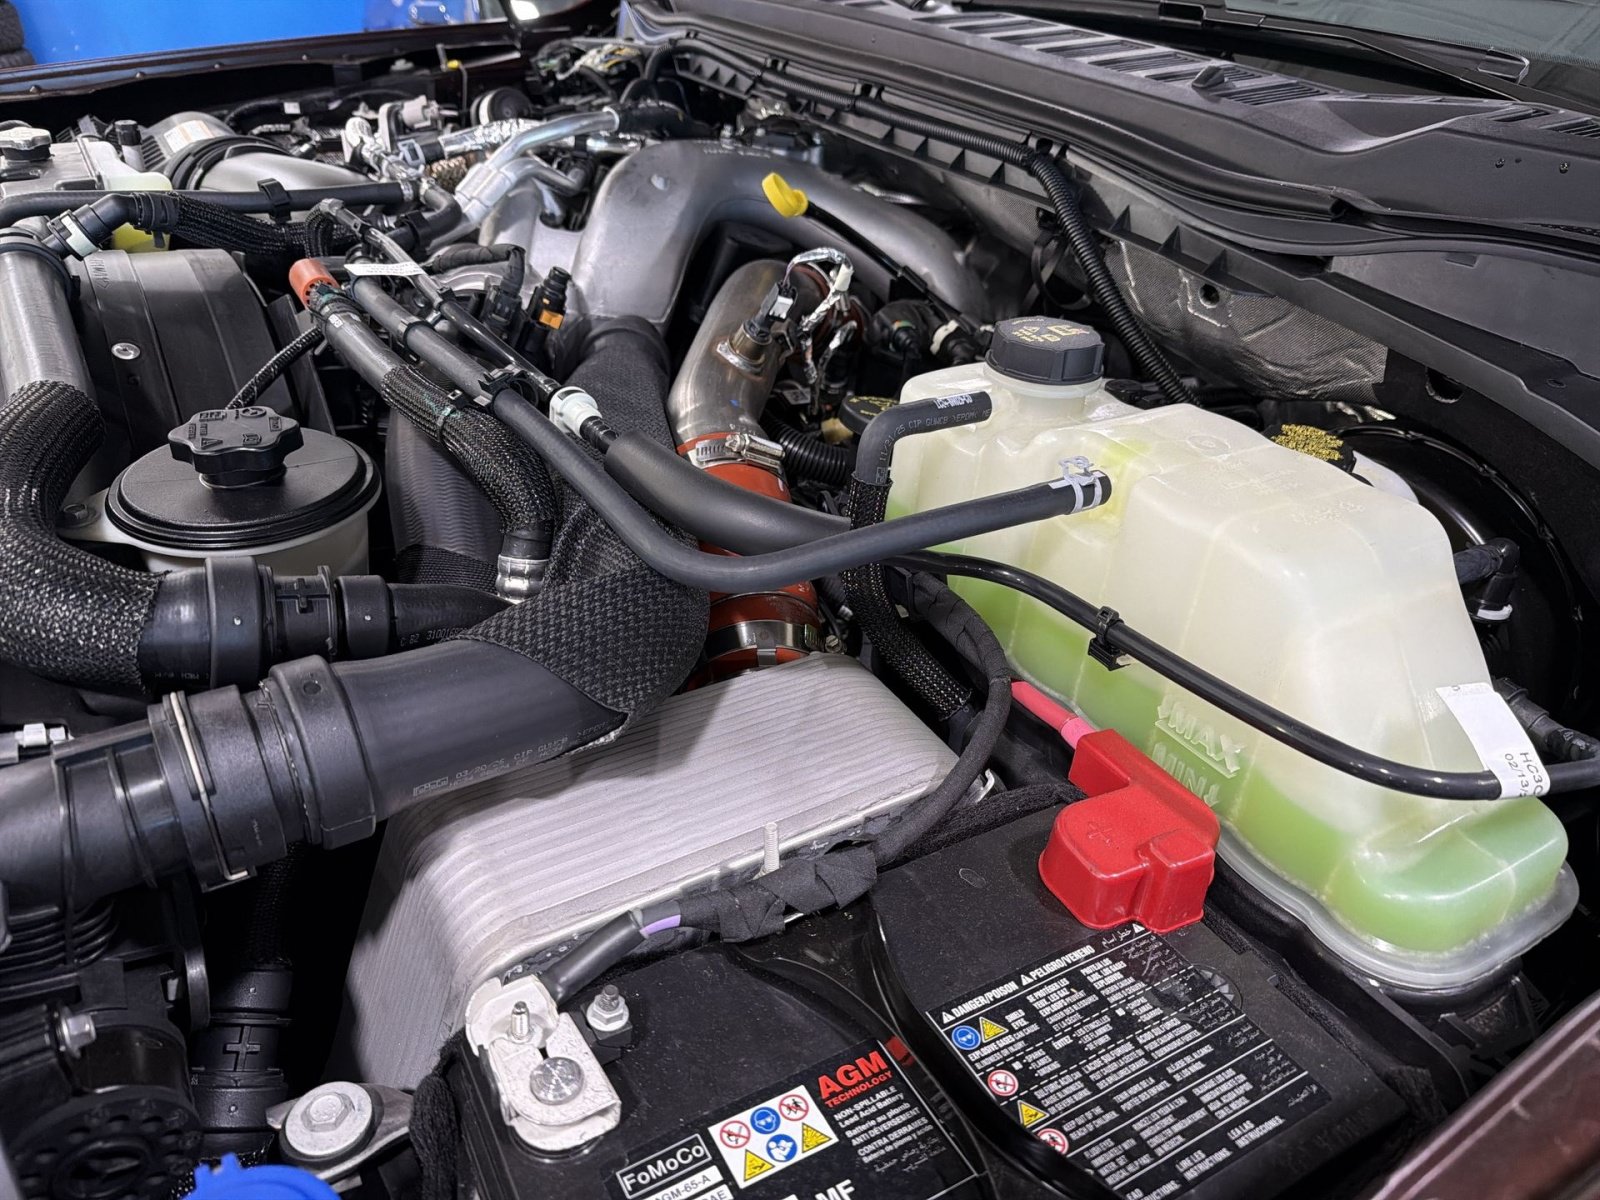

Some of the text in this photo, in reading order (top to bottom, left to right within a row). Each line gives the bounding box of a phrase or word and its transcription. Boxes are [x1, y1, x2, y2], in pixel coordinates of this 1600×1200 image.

[1165, 703, 1245, 773] MAX
[951, 981, 1018, 1016] DANGER/POISON
[1029, 945, 1094, 979] PELIGRO/VENENO
[818, 1051, 887, 1099] AGM
[825, 1071, 892, 1108] TECHNOLOGY
[834, 1086, 896, 1121] NON-SPILLABLE
[838, 1092, 904, 1128] Lead Acid Battery
[845, 1102, 911, 1138] Batterie au plomb
[851, 1107, 920, 1146] ANTI DÉVERSEMENT
[857, 1117, 928, 1156] CONTRA DERRAMES
[622, 1144, 705, 1192] FoMoCo
